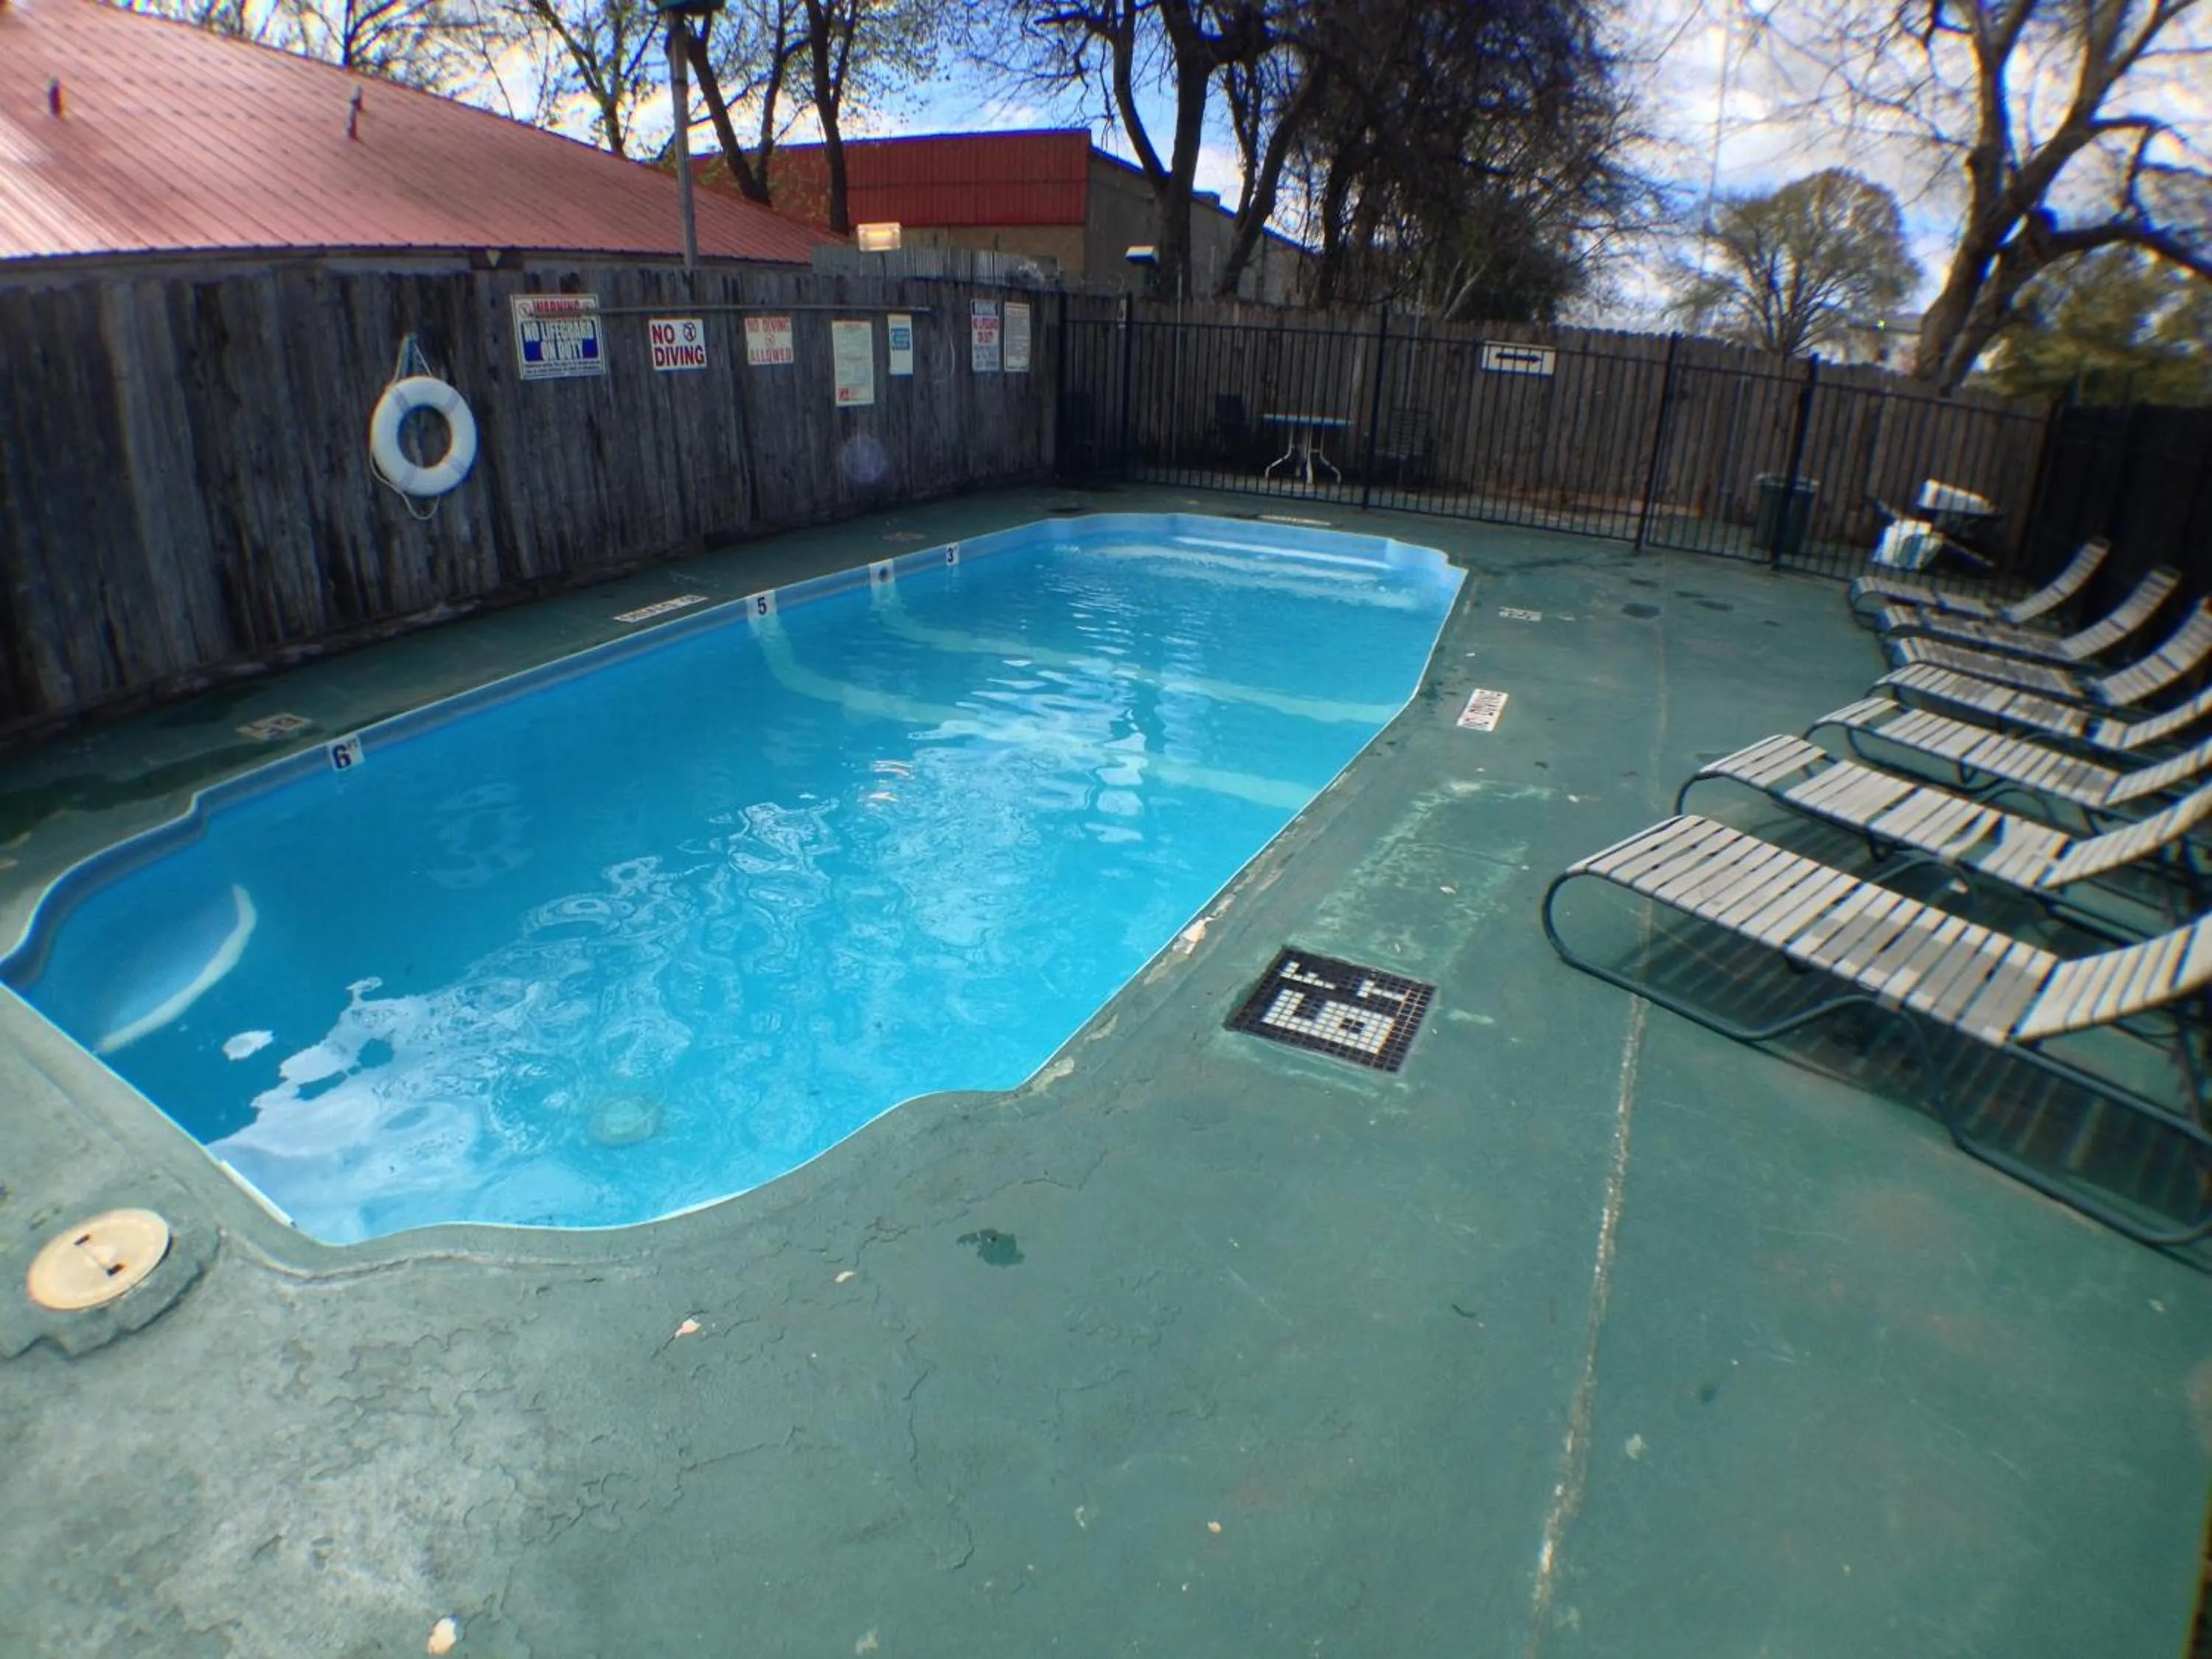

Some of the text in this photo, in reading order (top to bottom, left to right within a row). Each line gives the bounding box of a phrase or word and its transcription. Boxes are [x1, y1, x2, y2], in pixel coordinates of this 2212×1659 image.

[524, 319, 594, 342] NO LIFEGUARD
[652, 324, 675, 344] NO
[747, 317, 759, 333] NO
[541, 341, 558, 361] ON
[655, 345, 705, 366] DIVING
[750, 347, 791, 363] ALLOWED
[948, 547, 953, 563] 3
[758, 597, 767, 616] 5
[333, 744, 352, 769] 6
[1262, 987, 1397, 1054] 6
